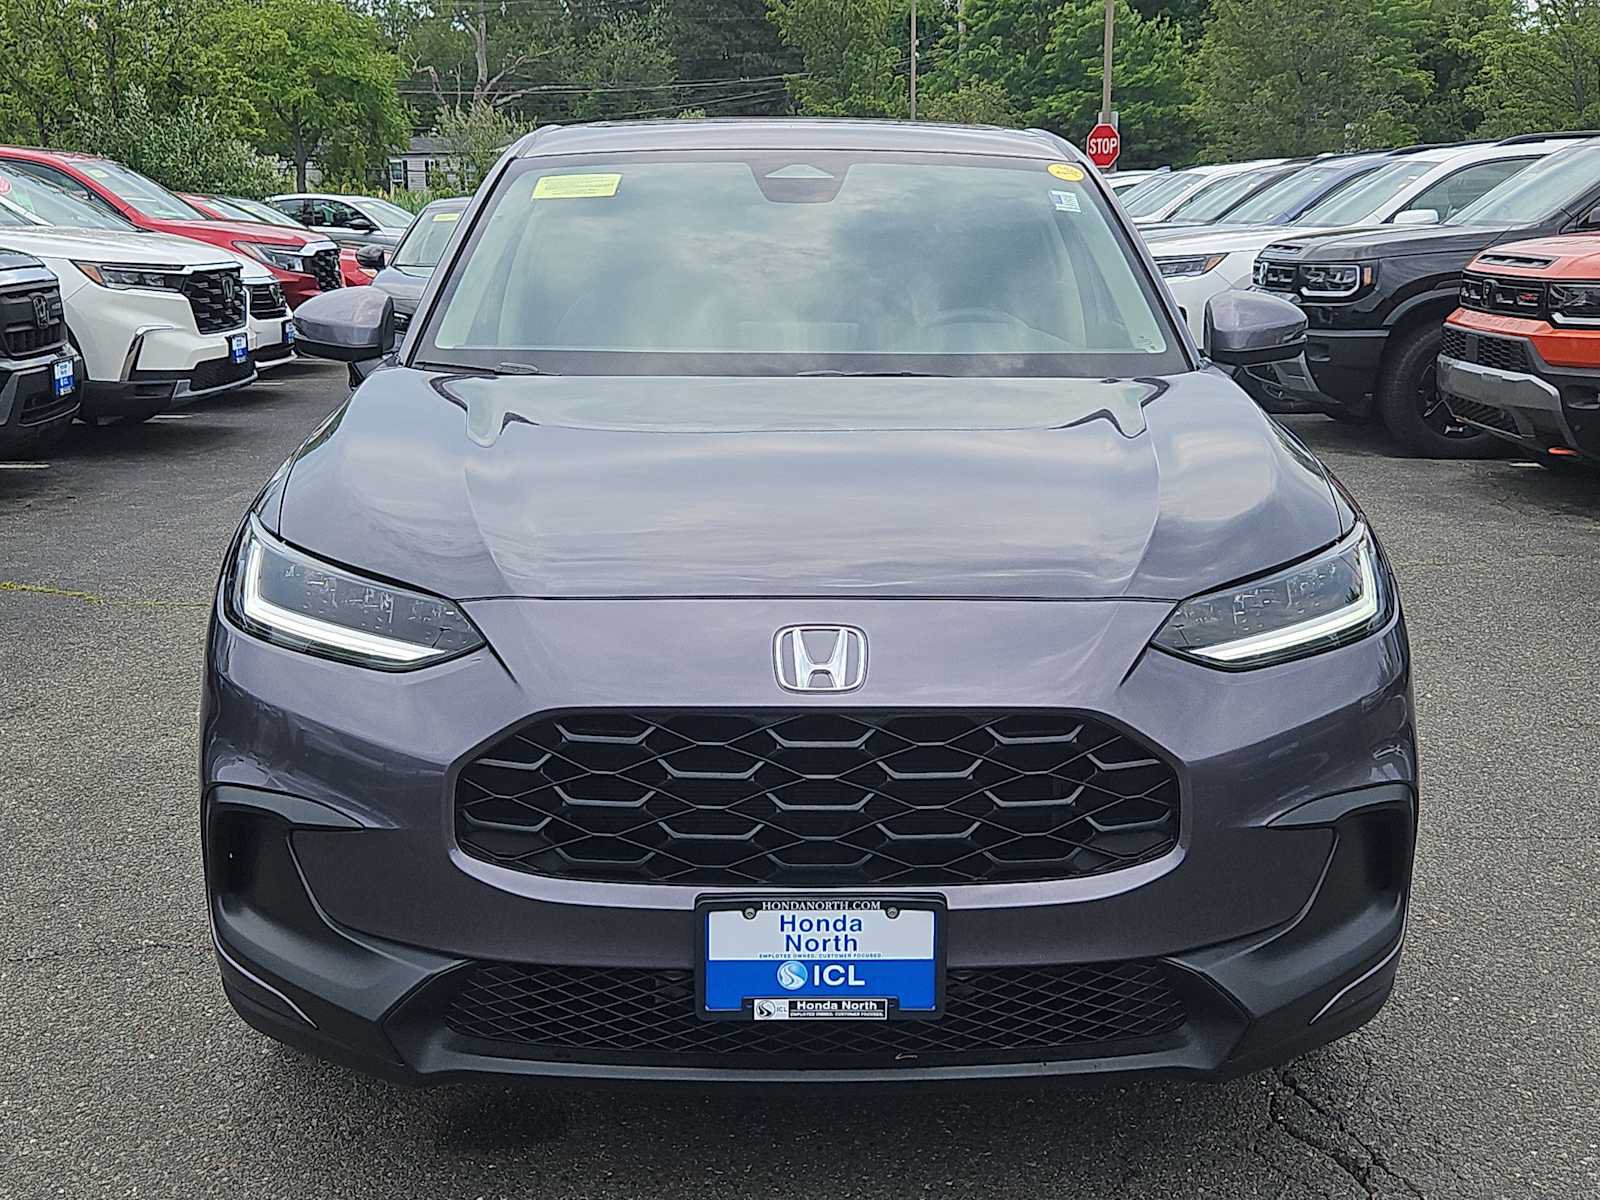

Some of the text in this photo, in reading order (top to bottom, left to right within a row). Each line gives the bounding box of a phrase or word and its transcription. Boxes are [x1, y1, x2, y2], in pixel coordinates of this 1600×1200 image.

[1089, 138, 1117, 155] STOP
[762, 900, 881, 911] HONDANORTH.COM
[780, 914, 863, 932] Honda
[785, 934, 858, 952] North
[813, 964, 866, 987] ICL
[796, 1001, 878, 1010] Honda North
